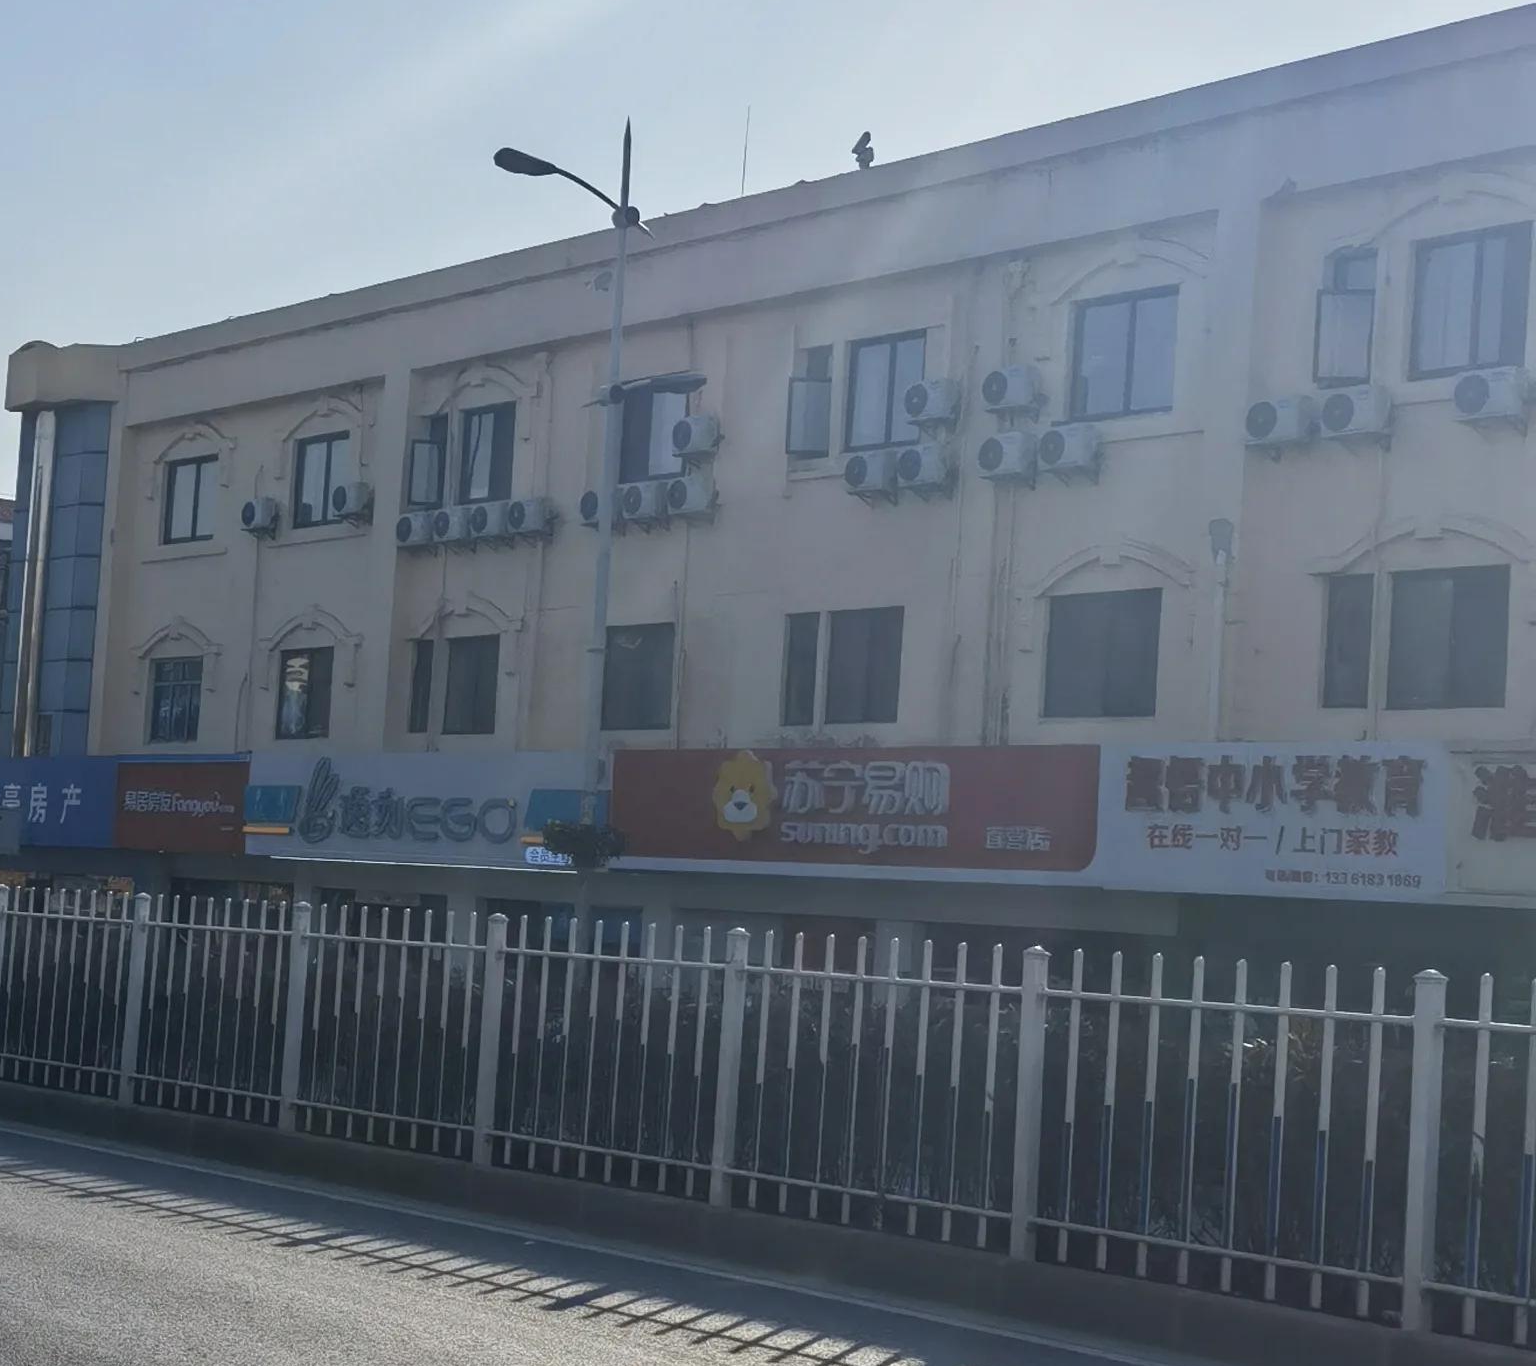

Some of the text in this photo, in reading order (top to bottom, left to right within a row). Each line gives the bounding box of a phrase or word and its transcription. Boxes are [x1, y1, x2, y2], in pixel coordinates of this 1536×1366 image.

[781, 759, 952, 816] 苏宁易购
[780, 821, 949, 855] suning.com
[984, 826, 1052, 852] 直营店
